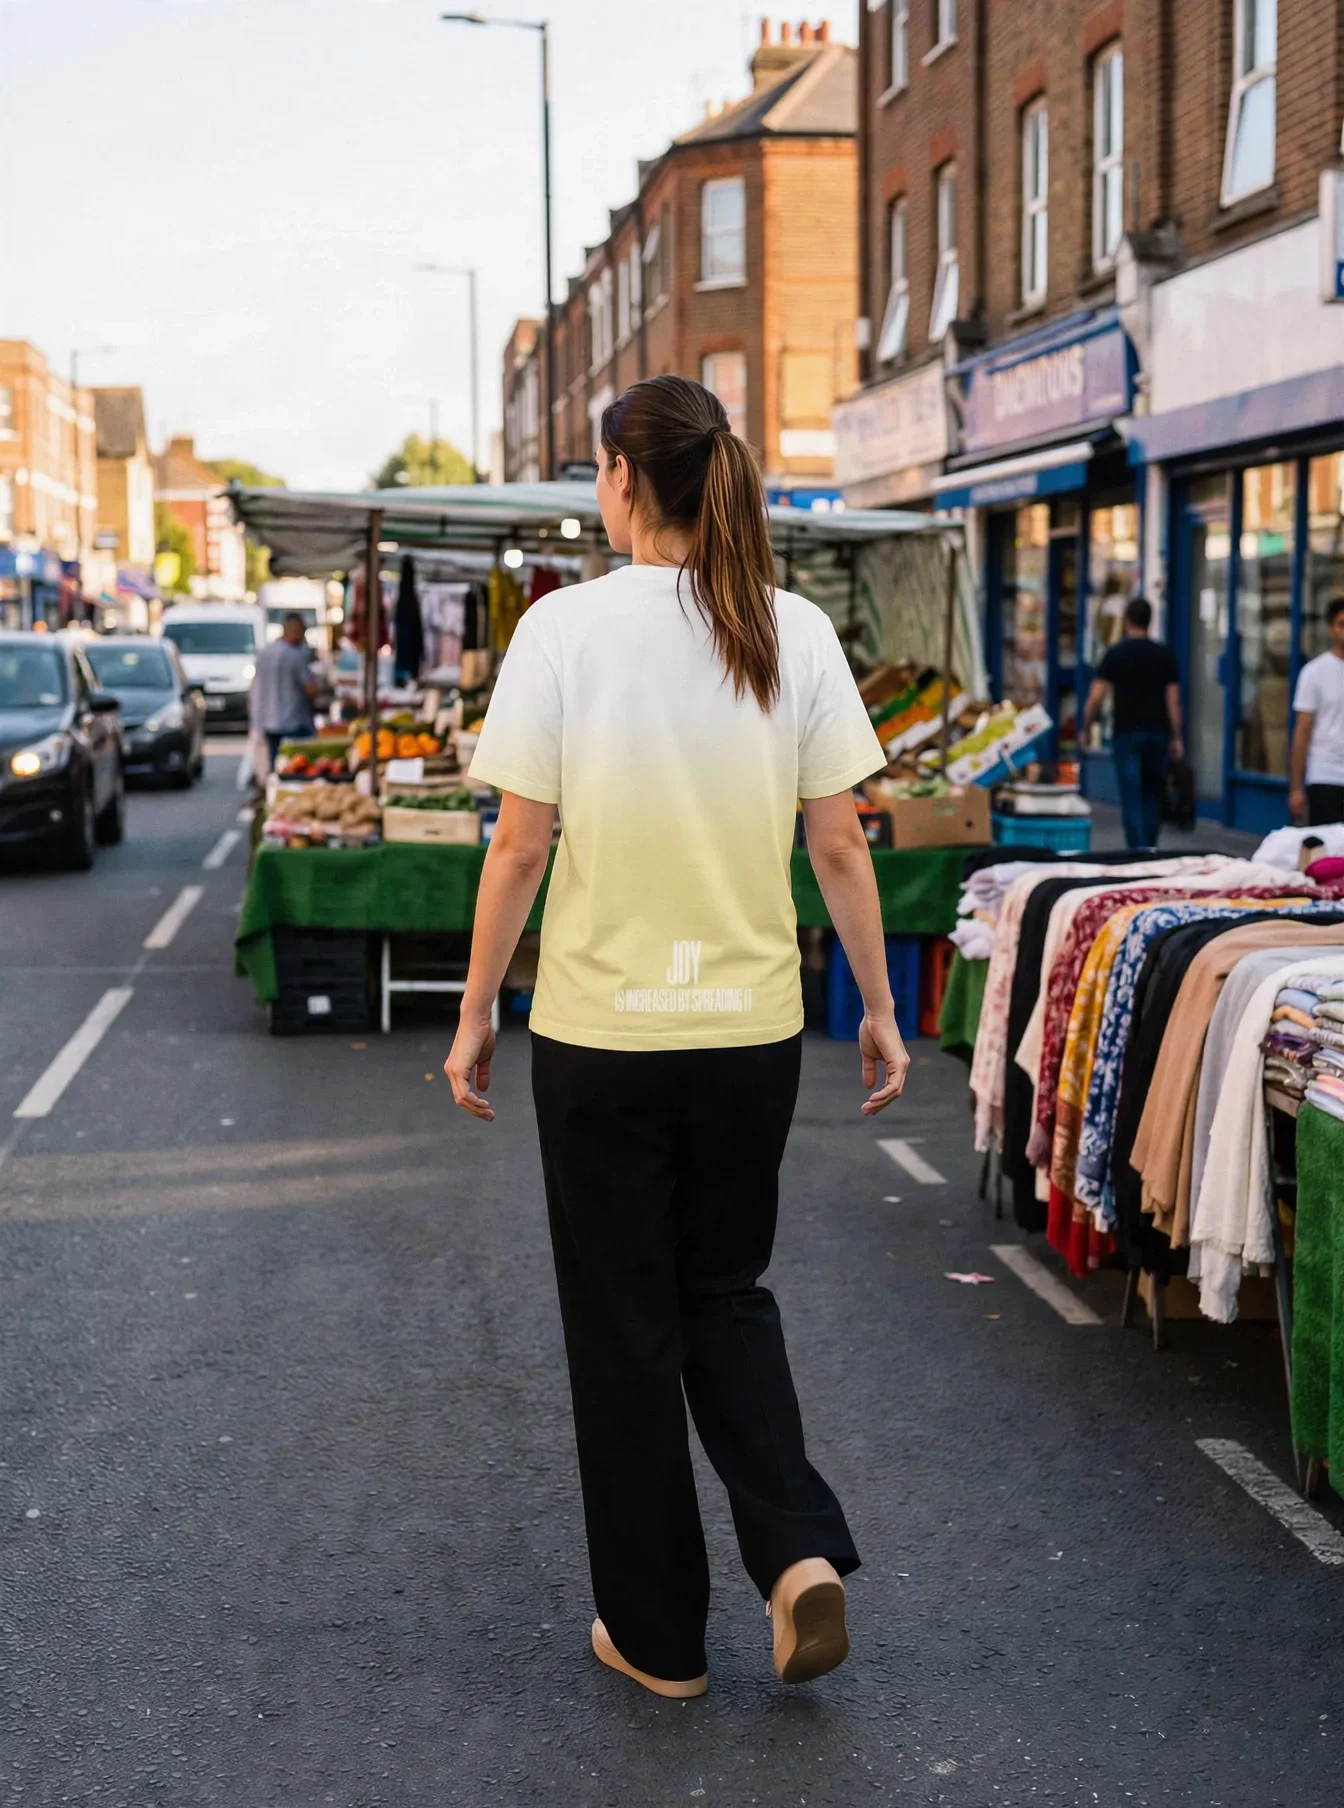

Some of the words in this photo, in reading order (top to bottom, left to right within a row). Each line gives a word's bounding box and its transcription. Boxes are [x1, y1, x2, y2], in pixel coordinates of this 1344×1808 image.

[666, 940, 702, 985] JOY
[614, 988, 625, 1012] IS
[626, 988, 677, 1012] INCREASED
[678, 988, 691, 1012] BY
[692, 988, 743, 1012] SPREADING
[744, 988, 753, 1012] IT
